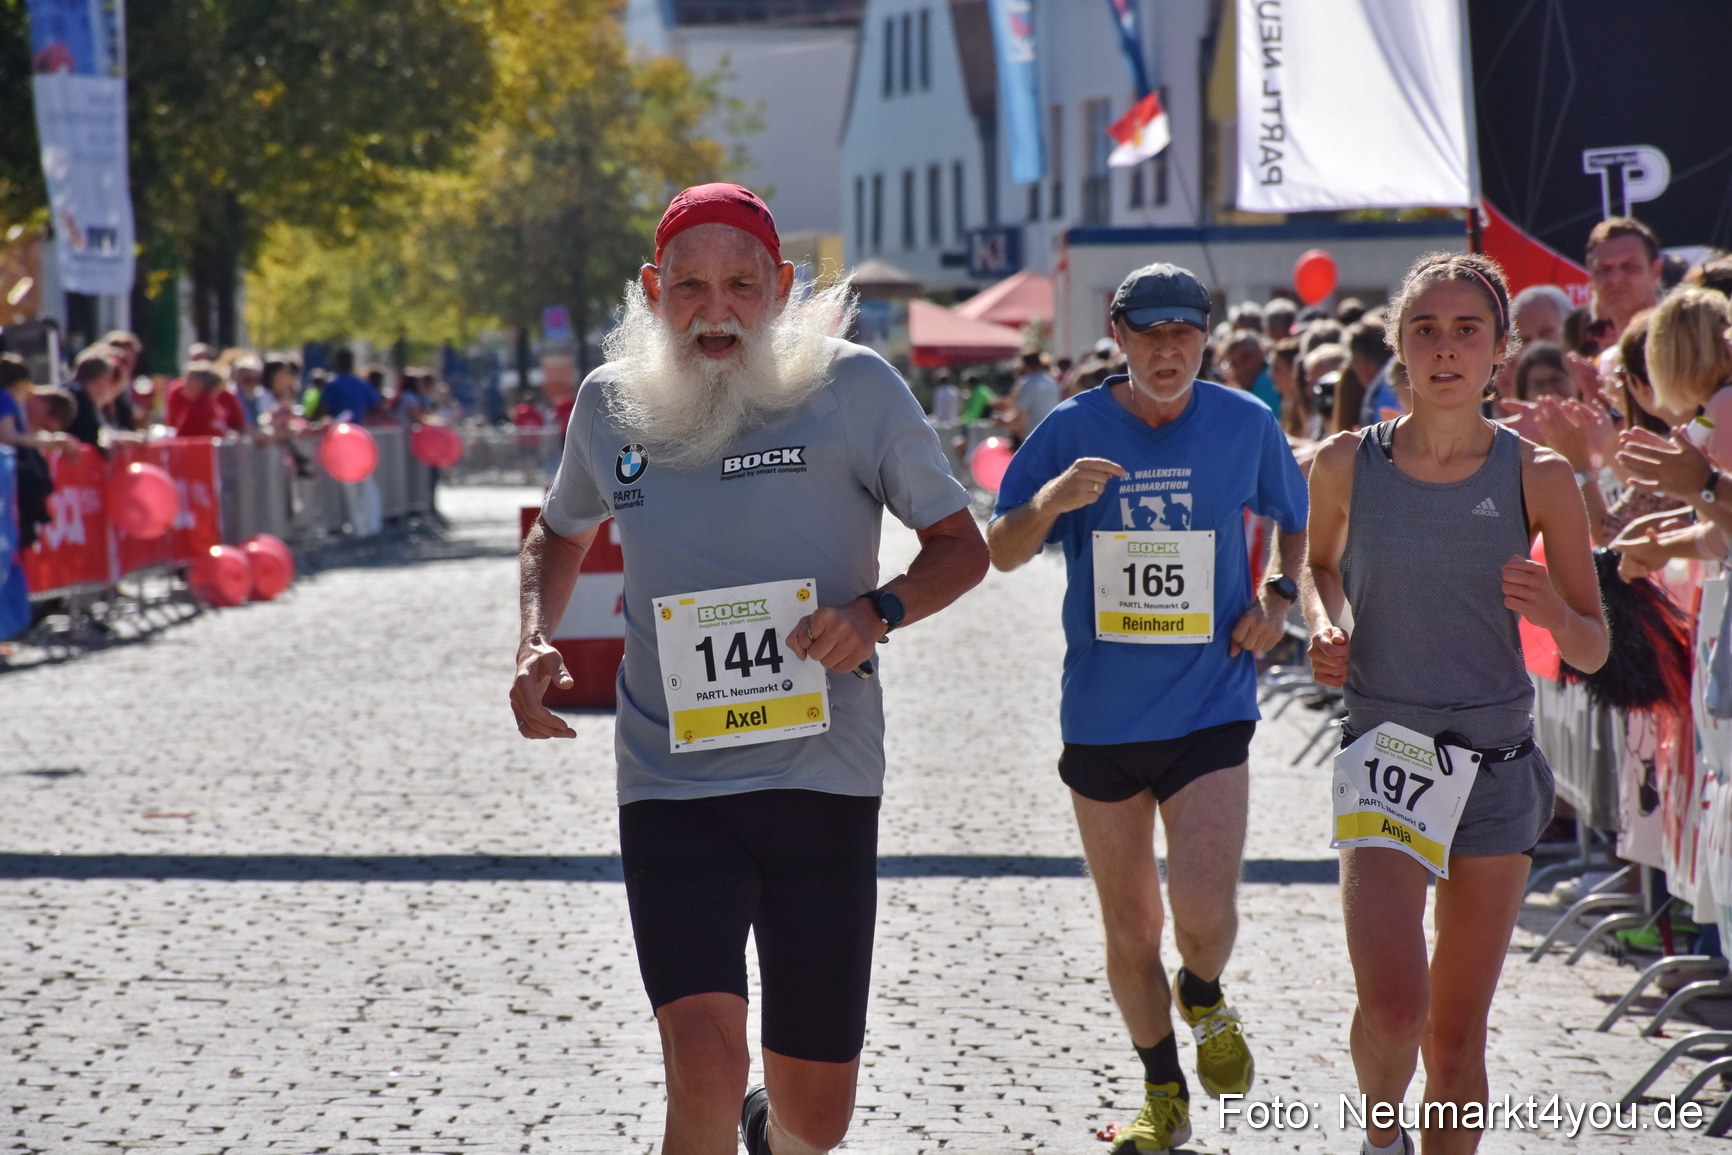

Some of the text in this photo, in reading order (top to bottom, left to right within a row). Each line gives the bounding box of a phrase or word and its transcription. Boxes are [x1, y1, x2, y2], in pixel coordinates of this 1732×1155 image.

[722, 446, 806, 475] BOCK
[720, 466, 807, 481] inspired by smart concepts
[1135, 468, 1192, 479] WALLENSTEIN
[613, 489, 645, 502] PARTL
[1119, 480, 1189, 494] HALBMARATHON
[614, 499, 644, 510] Neumarkt
[1472, 508, 1500, 517] adidas
[1128, 541, 1180, 554] BOCK
[1123, 563, 1185, 597] 165
[697, 599, 769, 623] BOCK
[1119, 601, 1142, 609] PARTL
[1123, 616, 1184, 631] Reinhard
[695, 627, 783, 682] 144
[696, 683, 778, 701] PARTL Neumarkt
[725, 705, 767, 729] Axel
[1375, 732, 1437, 767] BOCK
[1364, 757, 1434, 812] 197
[1359, 798, 1417, 826] PARTL Neumarkt
[1381, 818, 1411, 843] Anja
